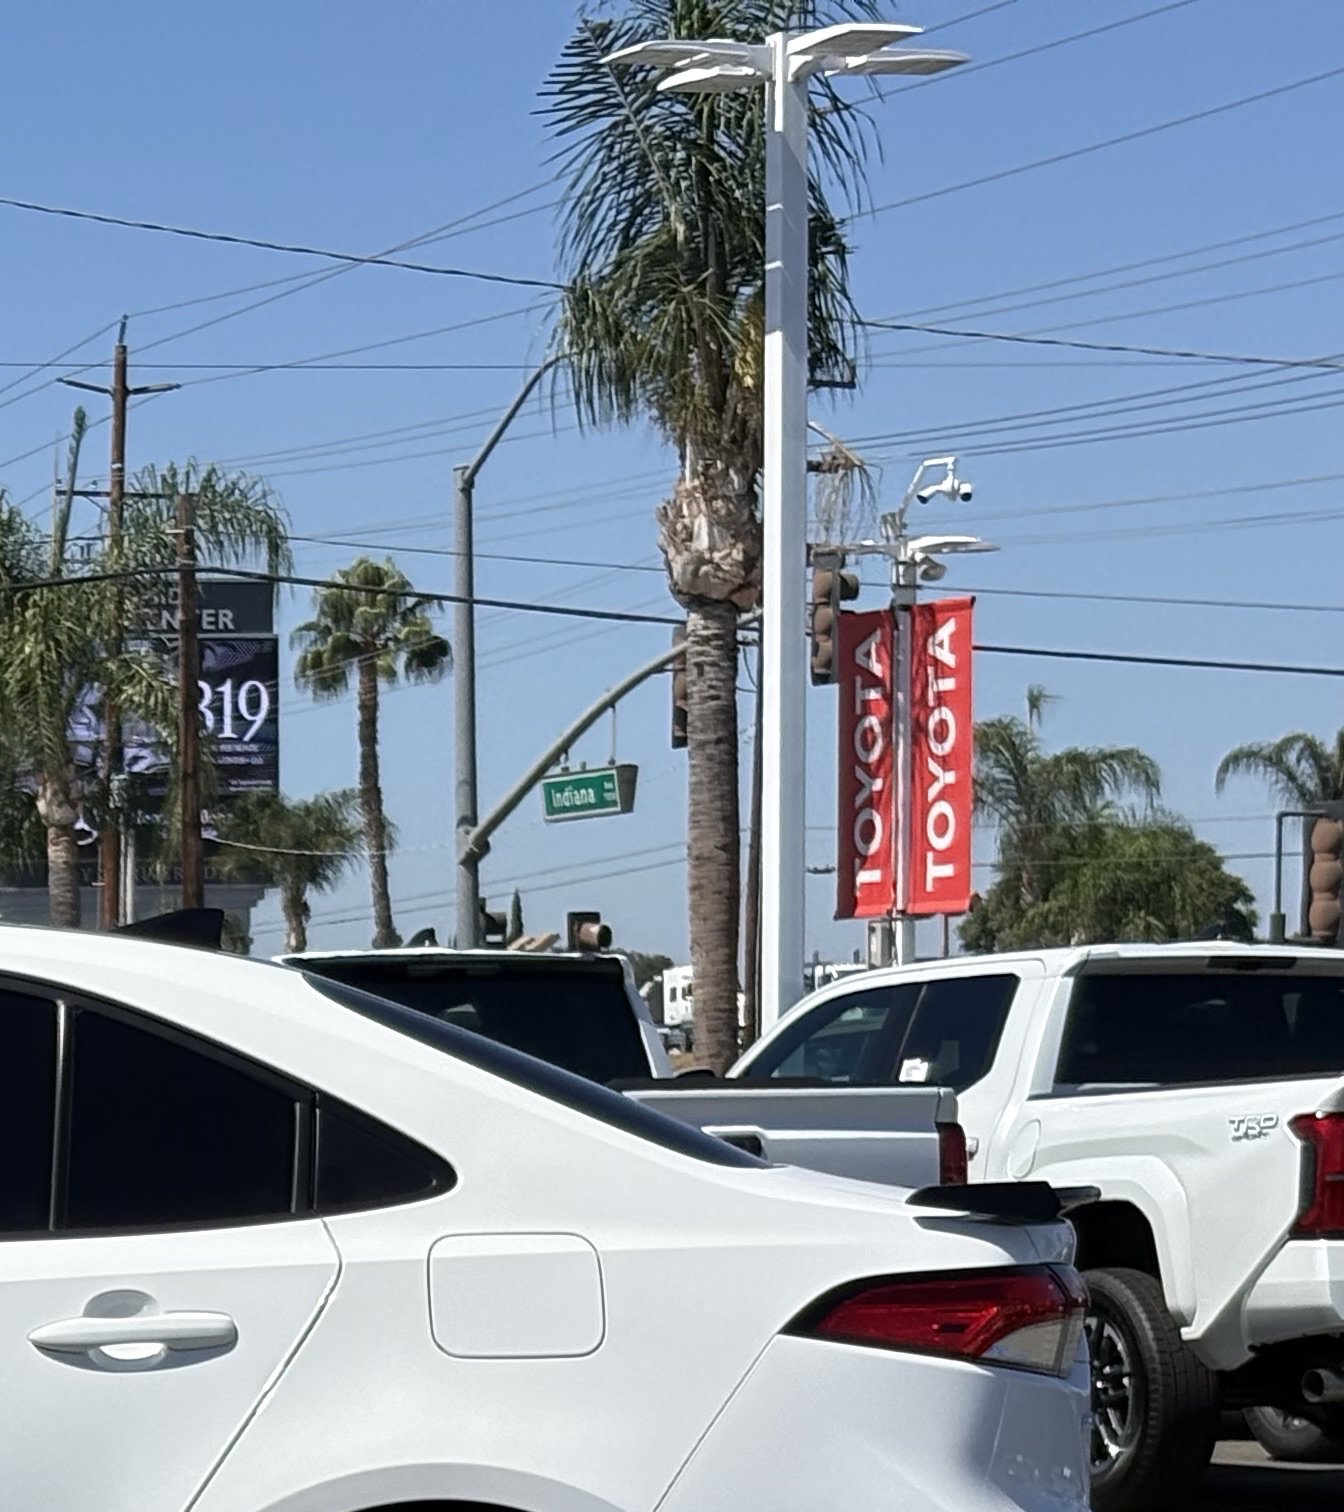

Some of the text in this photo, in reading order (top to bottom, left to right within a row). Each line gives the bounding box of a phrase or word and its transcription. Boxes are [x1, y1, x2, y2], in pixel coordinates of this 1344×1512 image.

[551, 785, 596, 808] Indiana
[853, 628, 884, 896] TOYOTA
[925, 616, 957, 893] TOYOTA
